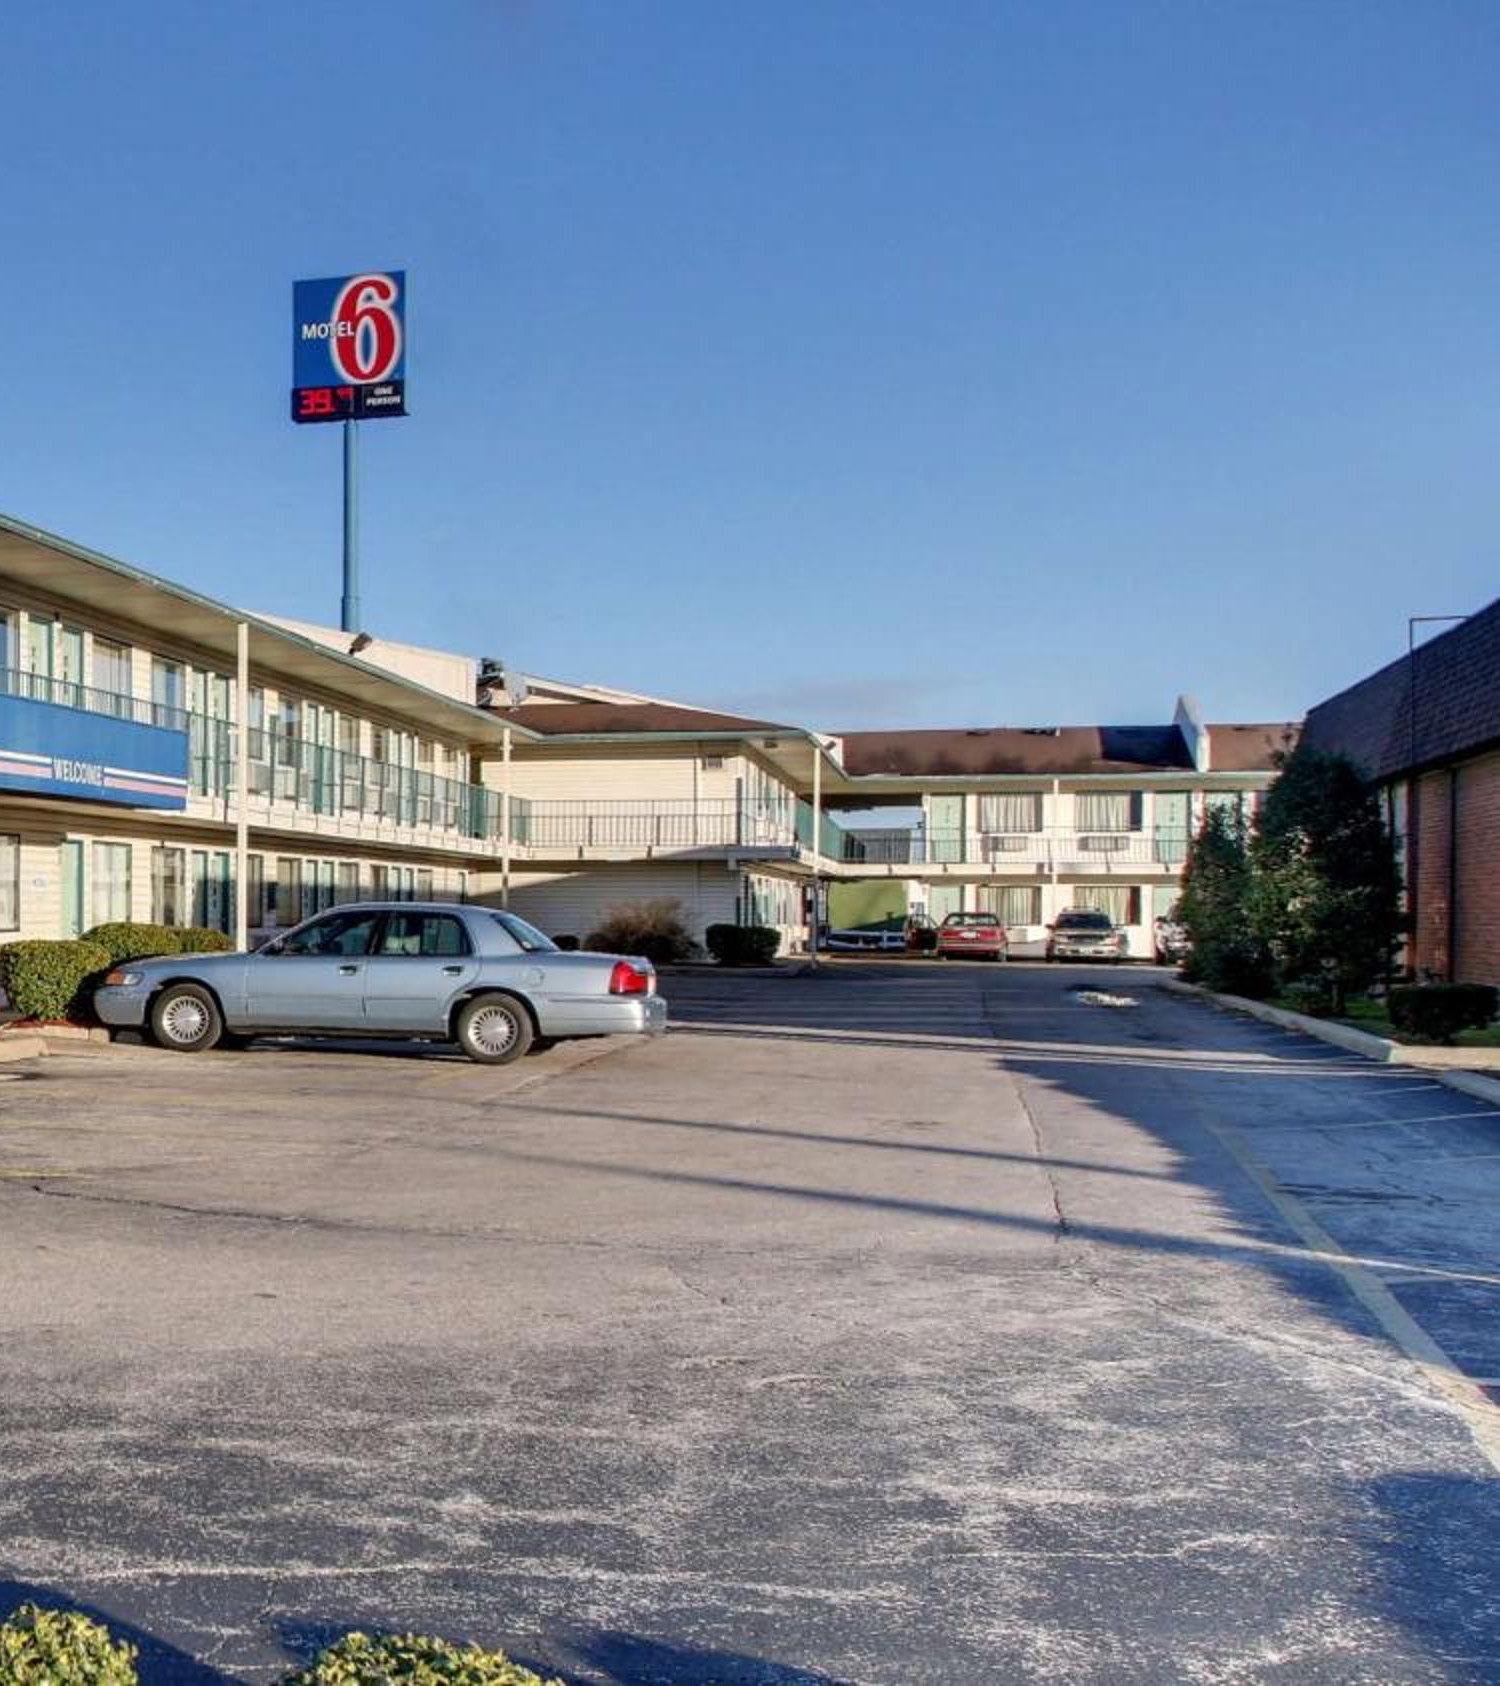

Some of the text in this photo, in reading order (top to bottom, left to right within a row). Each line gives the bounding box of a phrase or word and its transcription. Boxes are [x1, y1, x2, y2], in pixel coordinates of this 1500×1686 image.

[301, 273, 401, 384] MOTEL 6
[366, 395, 400, 407] PERSON
[52, 757, 101, 786] WELCOME
